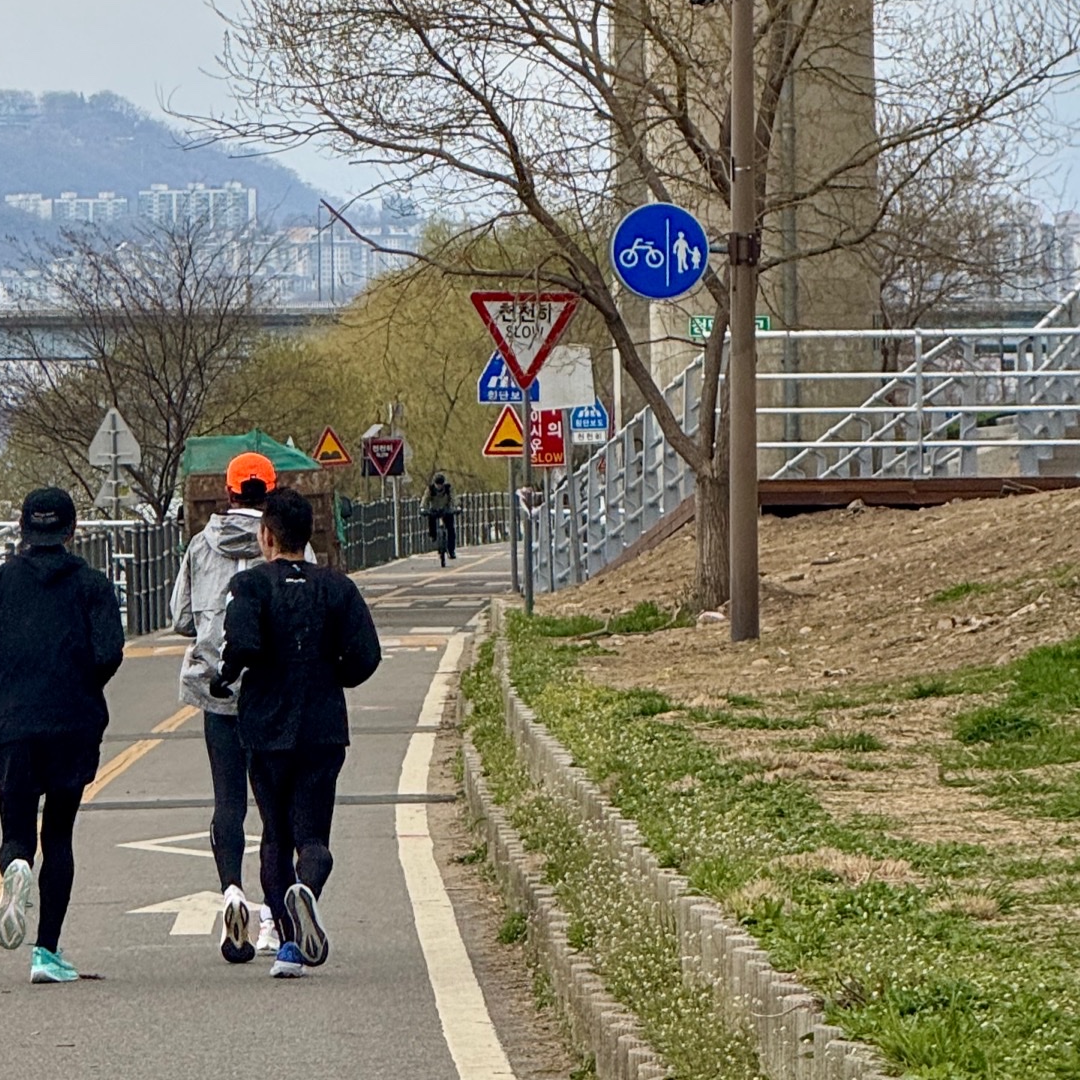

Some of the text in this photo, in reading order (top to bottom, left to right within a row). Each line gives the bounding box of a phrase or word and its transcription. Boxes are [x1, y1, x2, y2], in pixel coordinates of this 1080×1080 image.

[500, 303, 551, 323] 천천히
[506, 326, 544, 339] SLOW
[487, 390, 533, 400] 횡단보
[531, 452, 563, 463] SLOW
